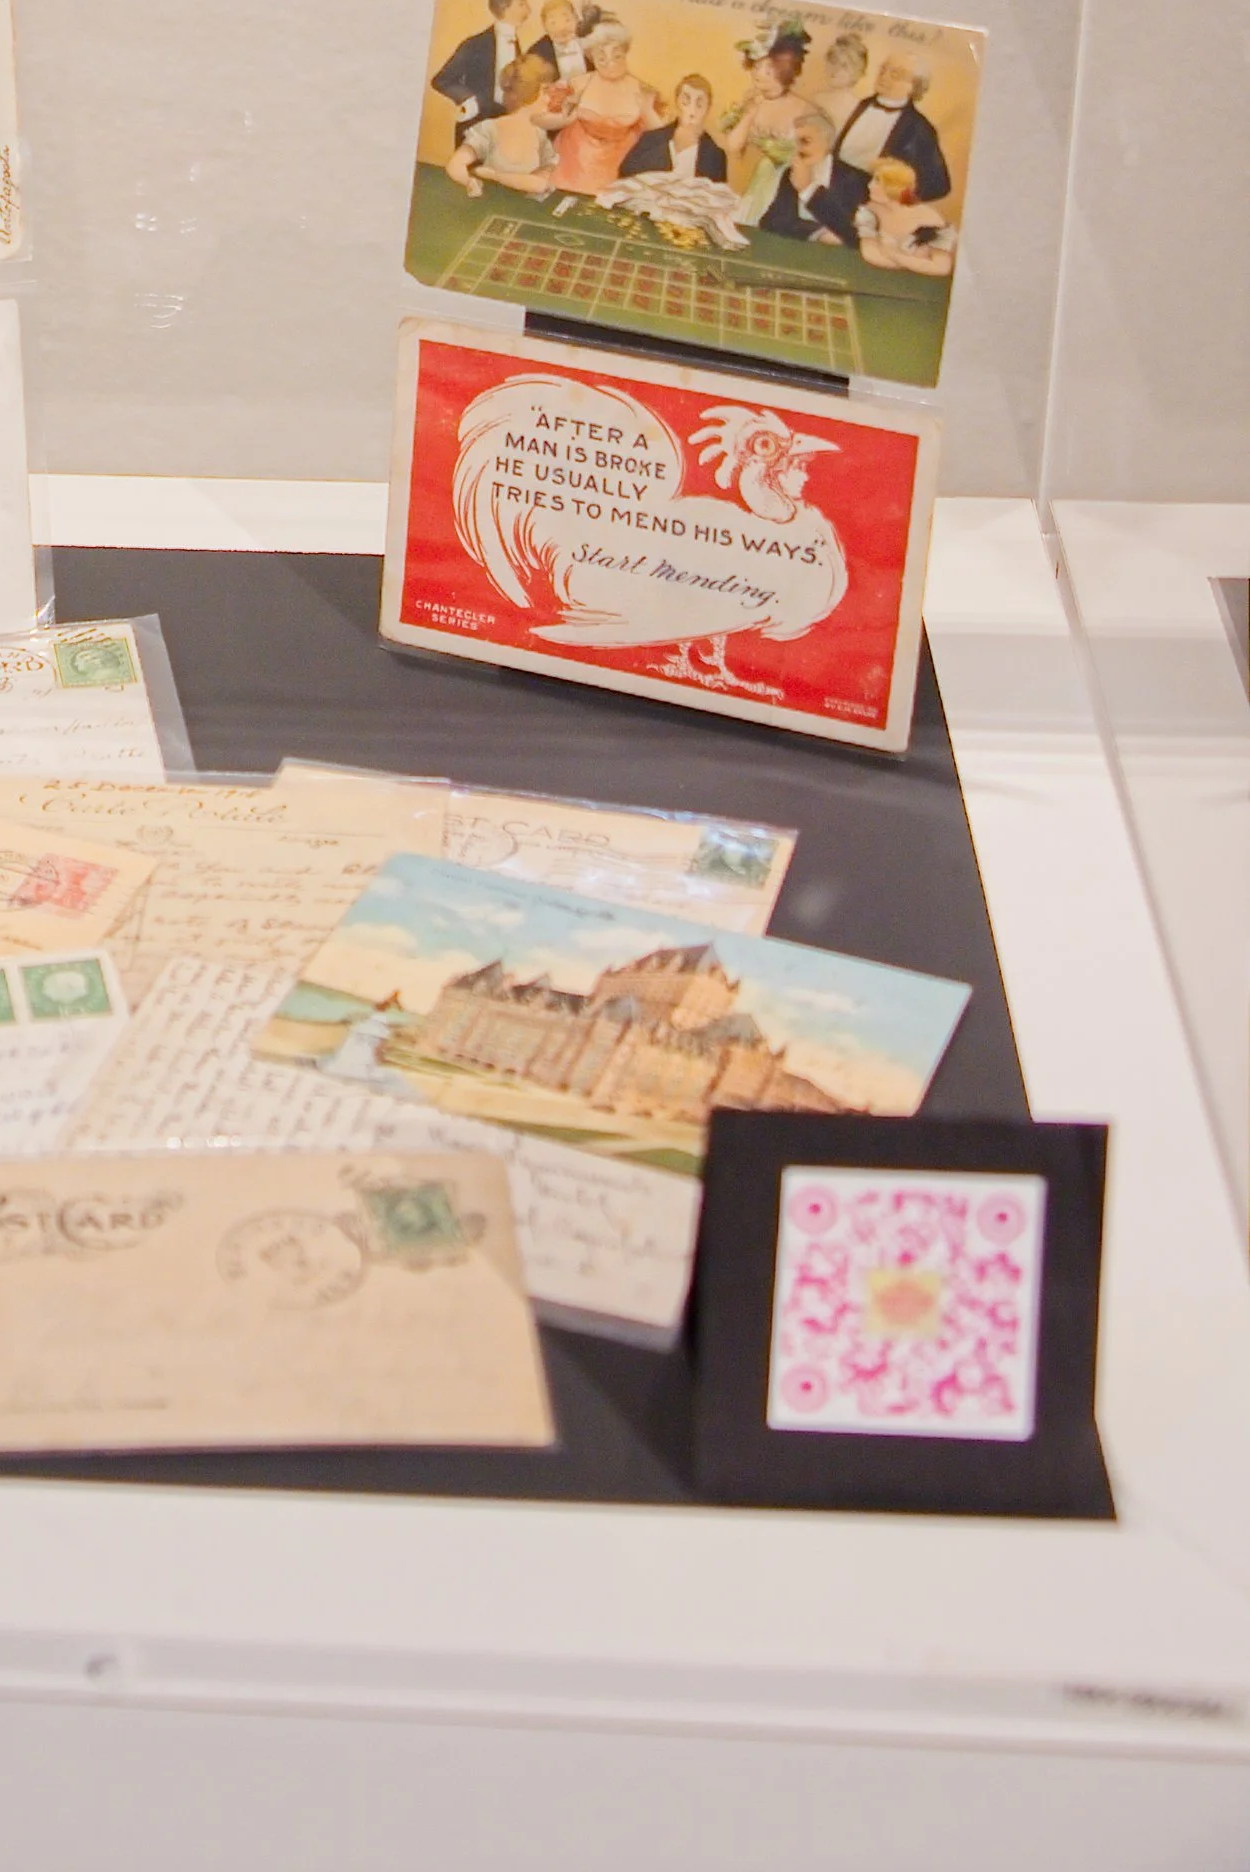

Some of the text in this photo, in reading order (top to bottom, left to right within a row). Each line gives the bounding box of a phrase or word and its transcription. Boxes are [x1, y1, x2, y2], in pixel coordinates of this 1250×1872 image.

[838, 11, 878, 33] like
[505, 431, 668, 481] MAN IS BROKE
[632, 433, 649, 451] A
[496, 456, 649, 502] HE USUALLY
[492, 481, 565, 512] TRIES
[571, 498, 603, 520] TO
[611, 507, 687, 537] MEND
[694, 524, 734, 547] HIS
[571, 542, 647, 576] Start
[414, 599, 496, 625] CHANTECLER
[431, 613, 479, 631] SERIES
